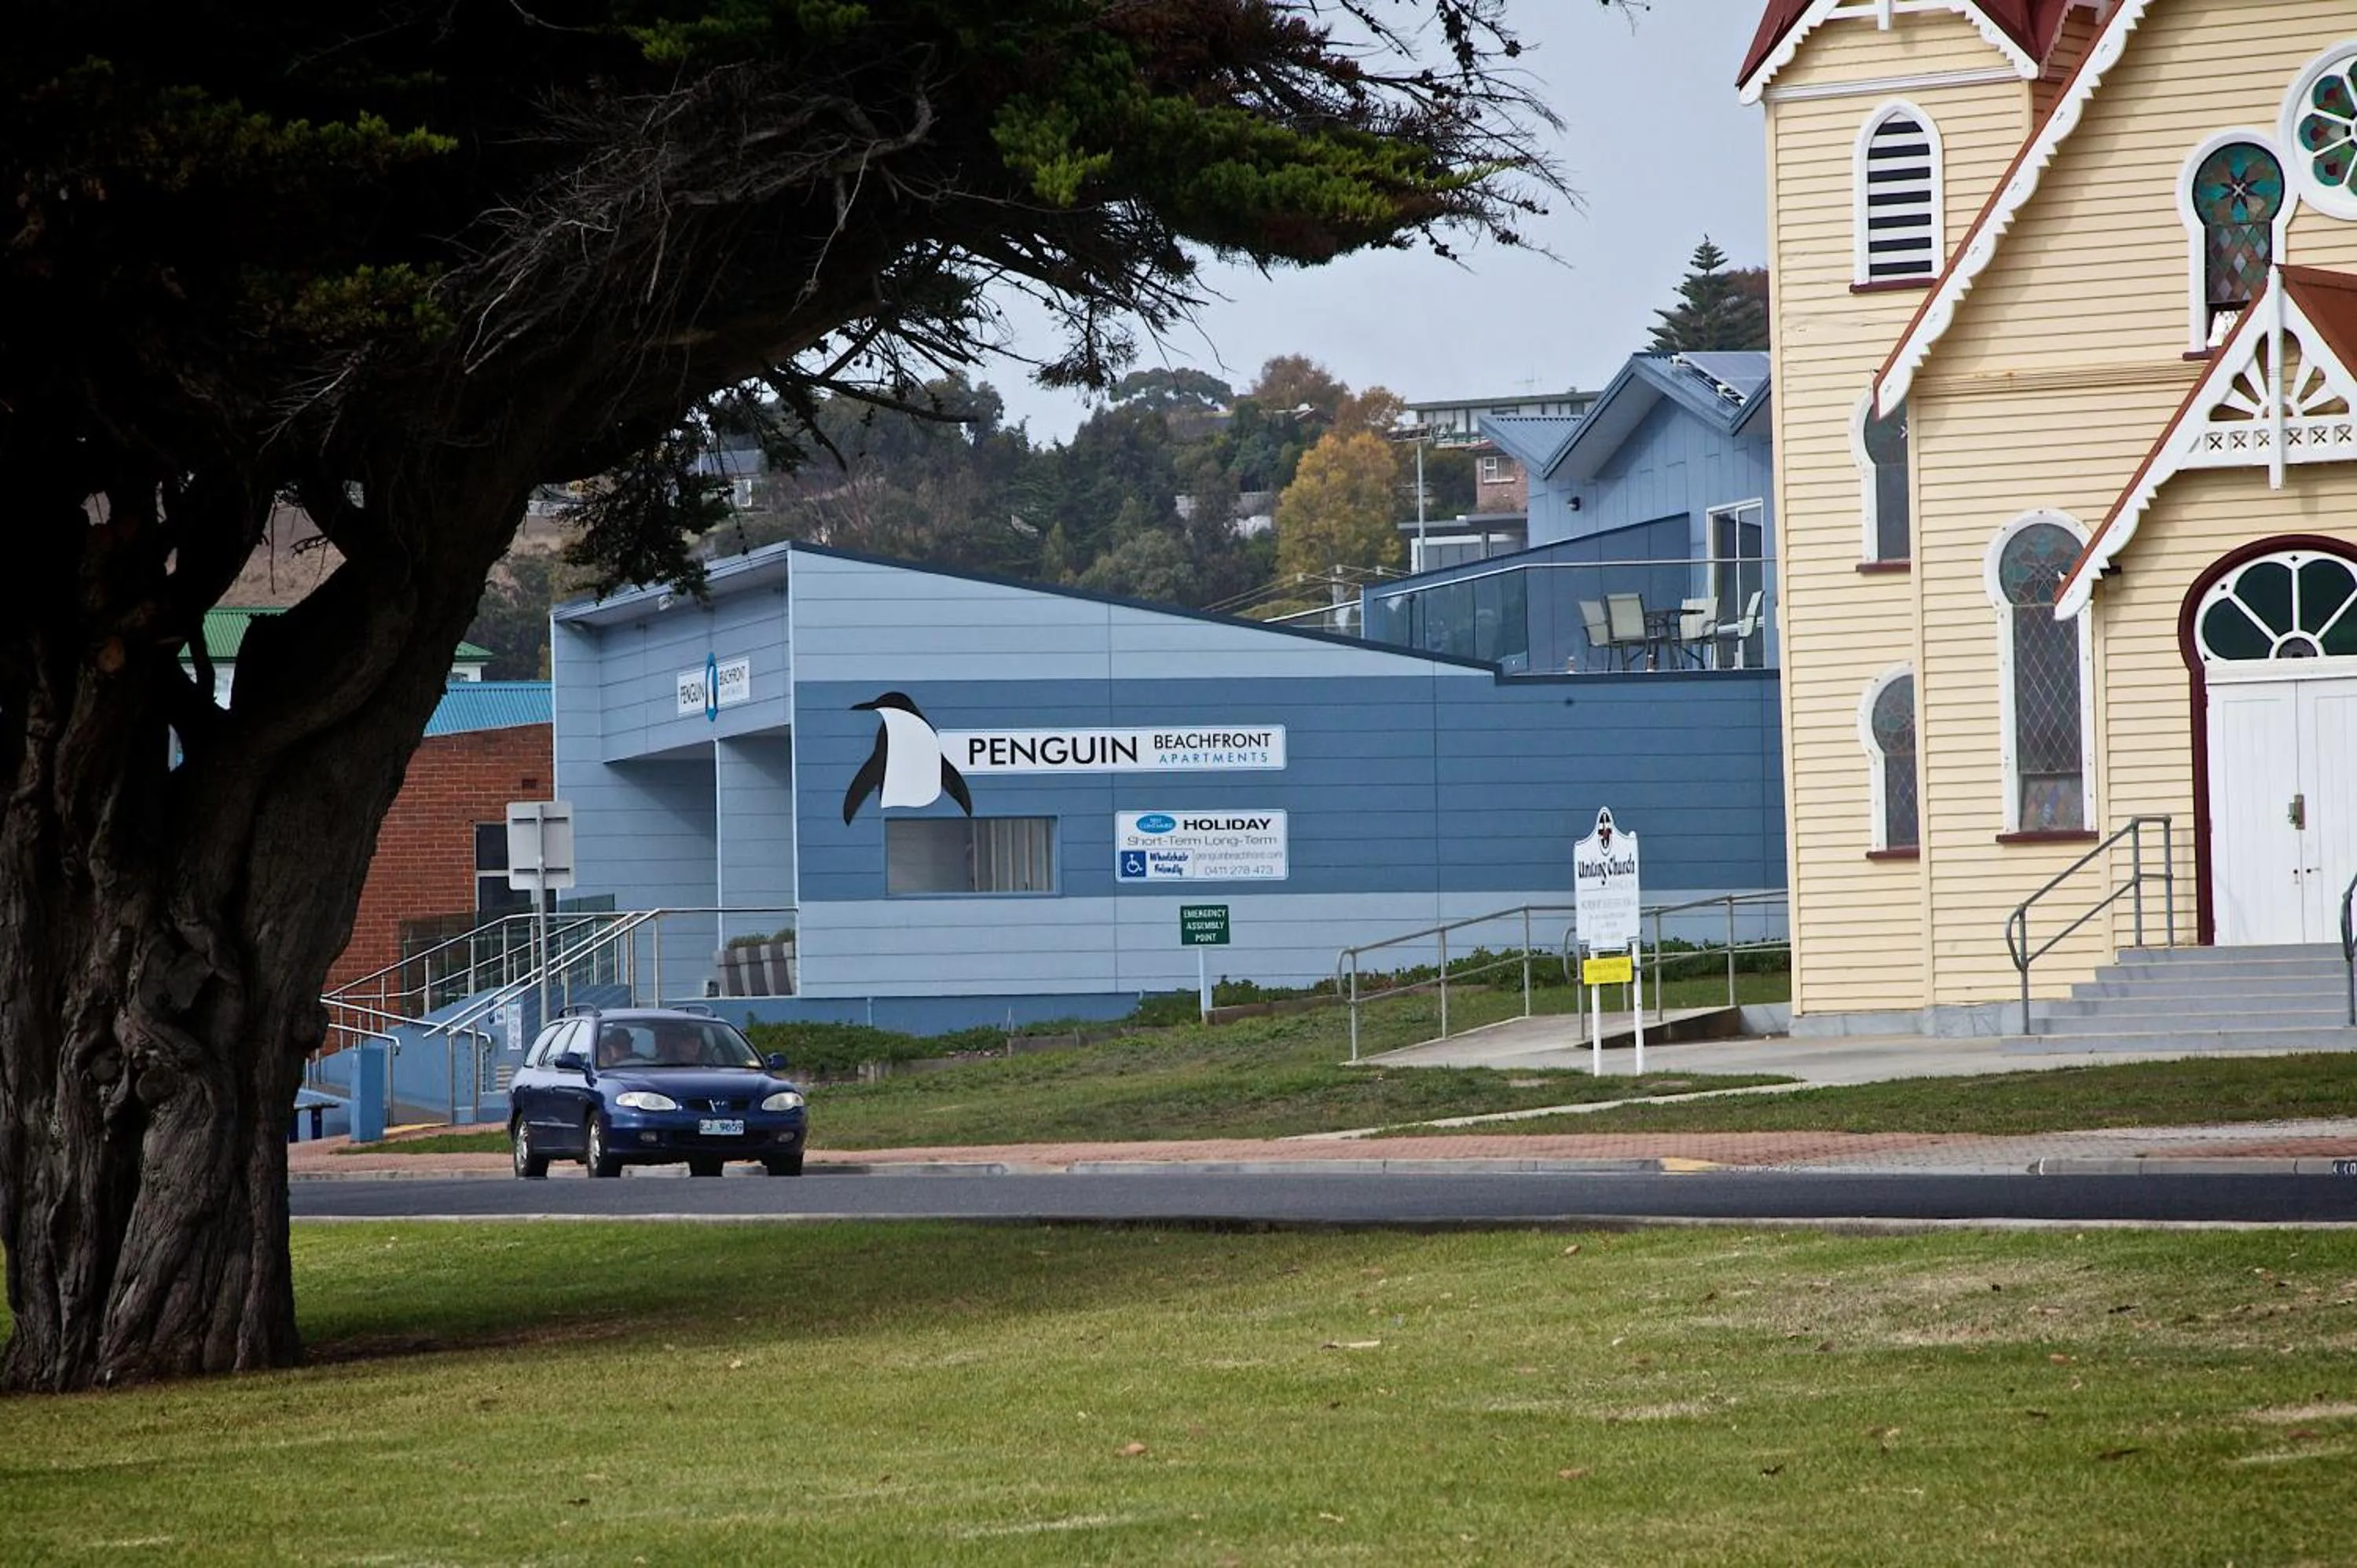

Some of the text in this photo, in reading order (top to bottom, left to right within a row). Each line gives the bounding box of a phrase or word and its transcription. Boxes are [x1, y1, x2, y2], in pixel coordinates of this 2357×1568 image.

[680, 681, 705, 705] PENGUIN
[1154, 733, 1271, 749] BEACHFRONT
[969, 736, 1138, 765] PENGUIN
[1159, 752, 1267, 764] APARTMENTS
[1183, 818, 1271, 830] HOLIDAY
[1183, 909, 1226, 918] EMERGENCY
[1186, 920, 1224, 930] ASSEMBLY
[1195, 932, 1216, 942] POINT
